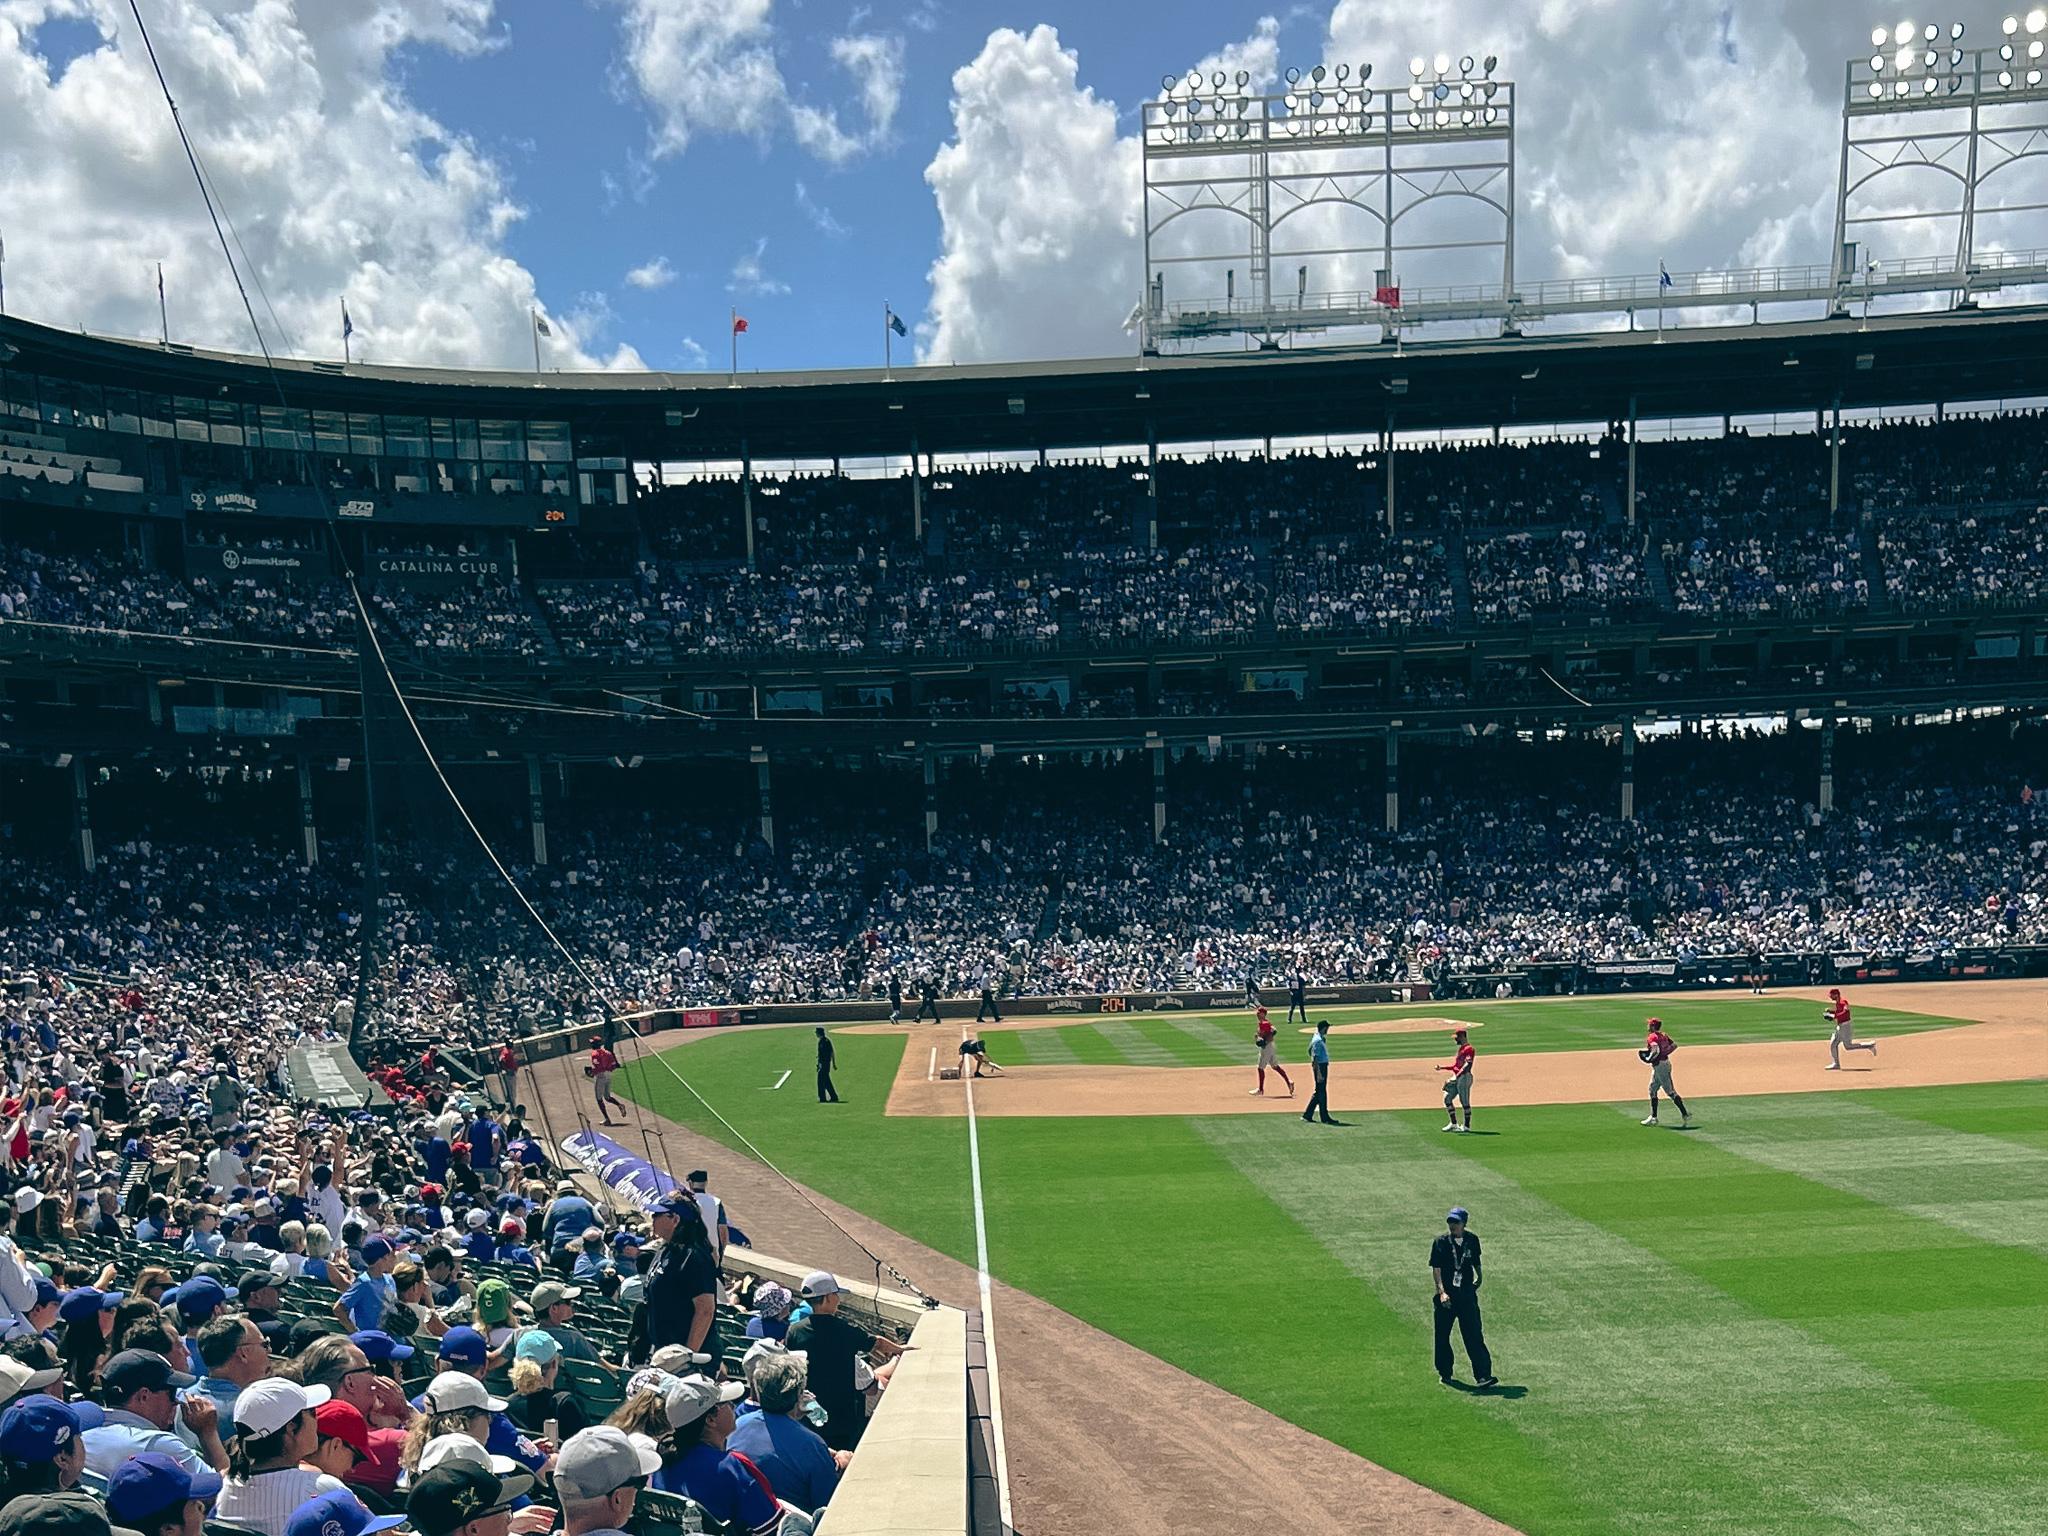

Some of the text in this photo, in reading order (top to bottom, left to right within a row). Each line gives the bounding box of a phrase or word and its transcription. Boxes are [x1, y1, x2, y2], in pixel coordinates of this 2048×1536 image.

[380, 561, 498, 573] CATALINA CLUB
[1047, 999, 1083, 1010] MARQUEE
[1101, 998, 1126, 1012] 204
